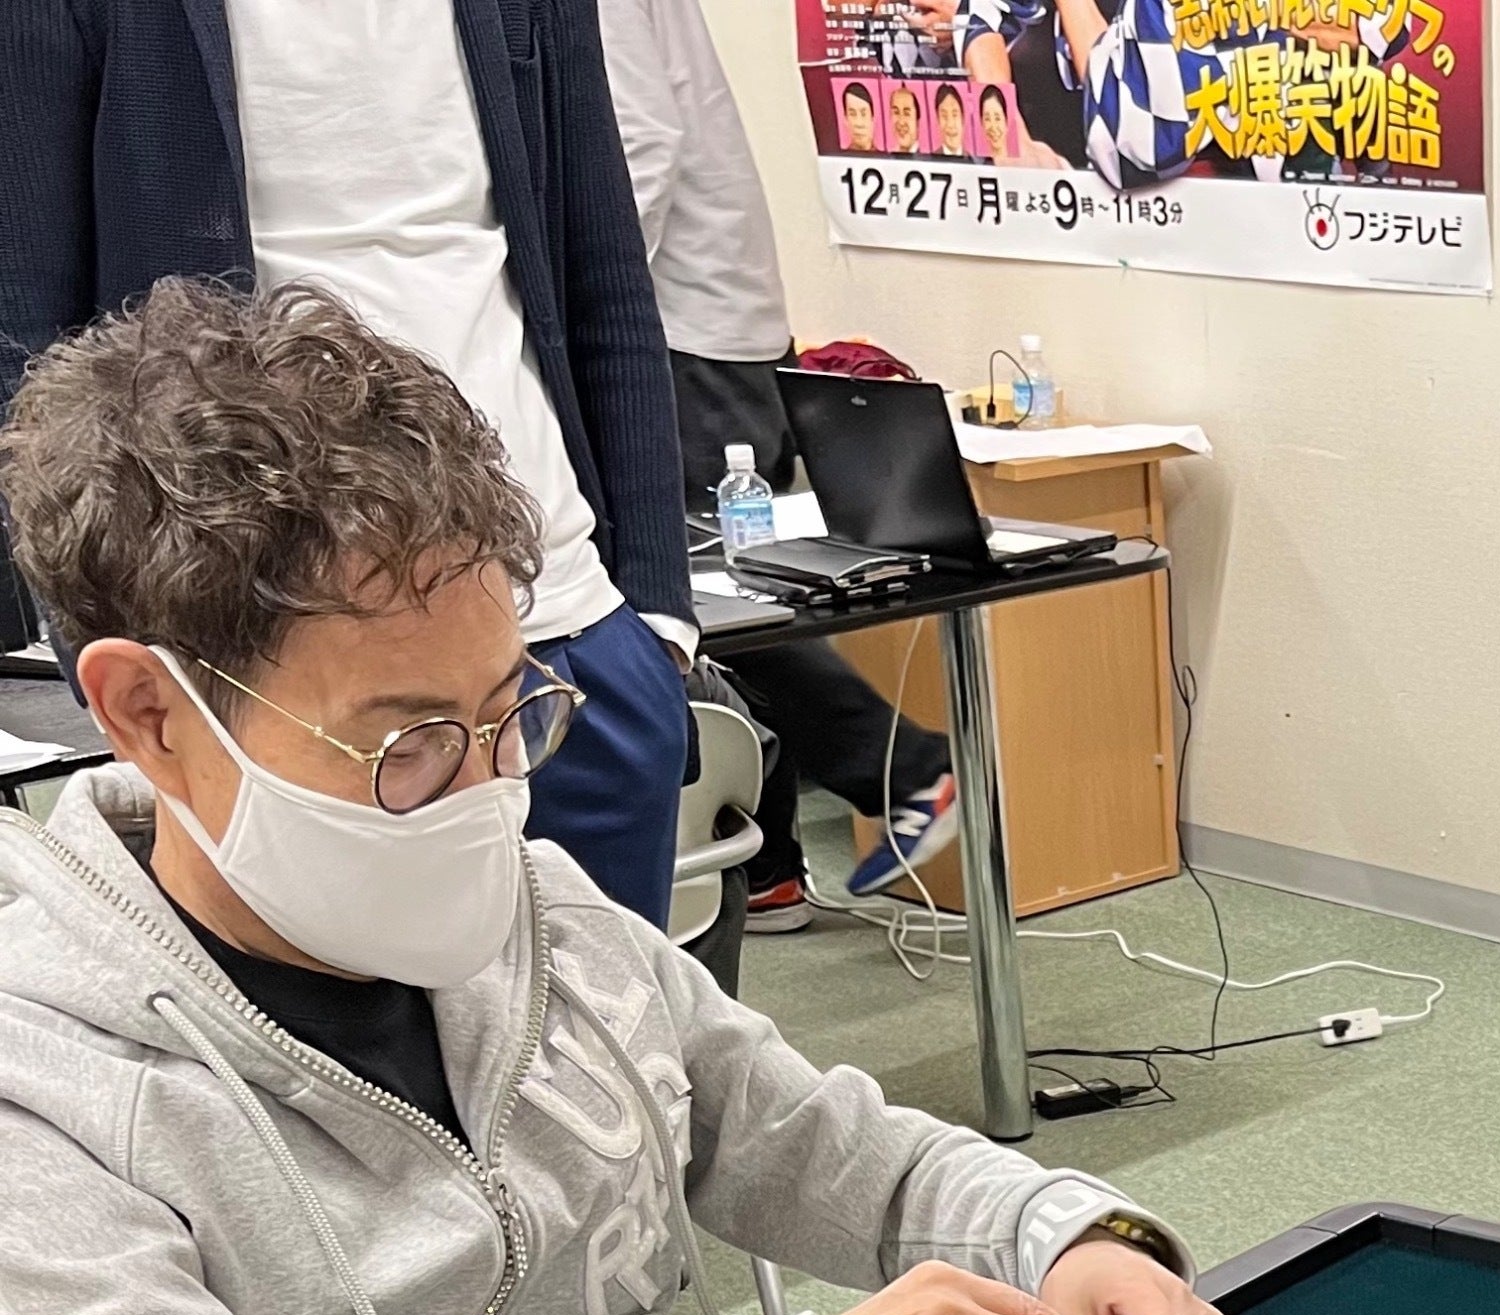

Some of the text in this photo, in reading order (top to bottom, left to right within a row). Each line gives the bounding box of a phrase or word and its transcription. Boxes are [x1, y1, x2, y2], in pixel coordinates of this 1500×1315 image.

[1184, 36, 1442, 169] 大爆笑物語
[1343, 210, 1463, 248] フジテレビ
